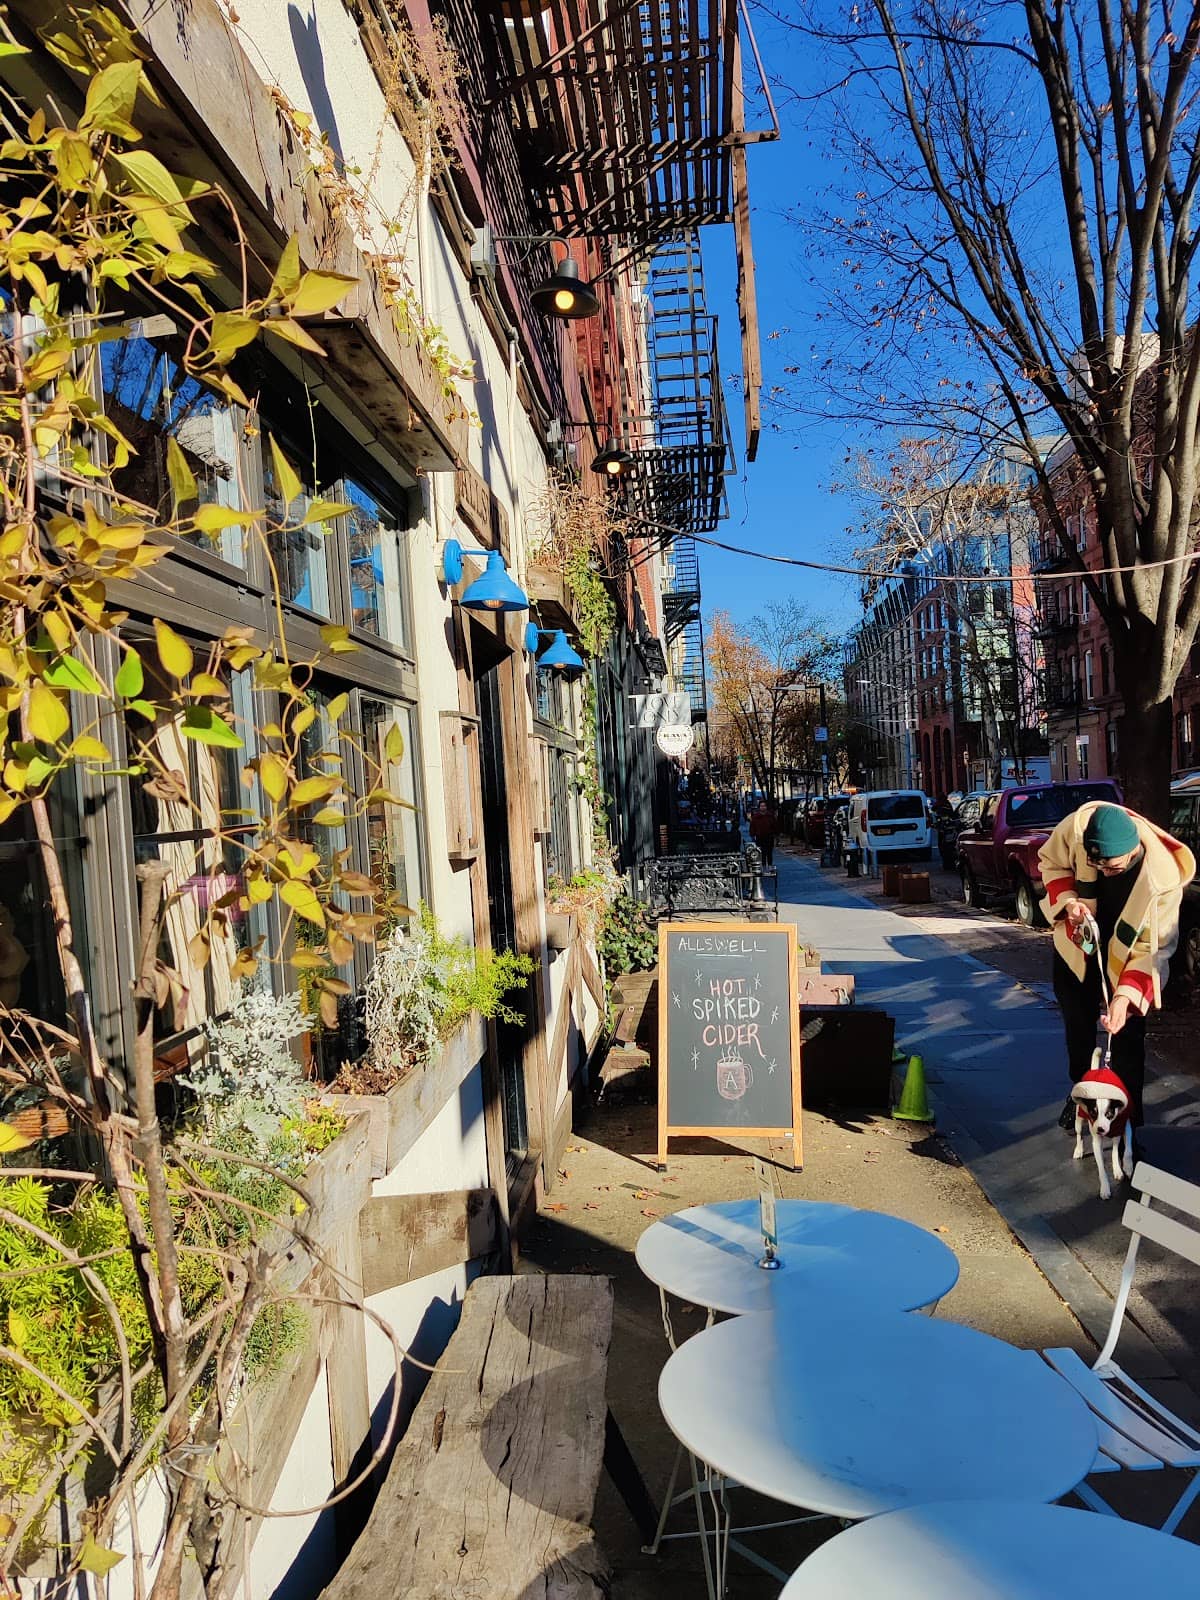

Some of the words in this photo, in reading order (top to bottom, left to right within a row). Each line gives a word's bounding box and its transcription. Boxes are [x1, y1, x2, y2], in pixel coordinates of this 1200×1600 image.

[1007, 768, 1037, 778] Rer
[678, 936, 767, 952] ALLSWELL
[709, 978, 746, 998] HOT
[692, 997, 761, 1021] SPIKED
[702, 1023, 767, 1059] CIDER
[723, 1071, 743, 1089] A
